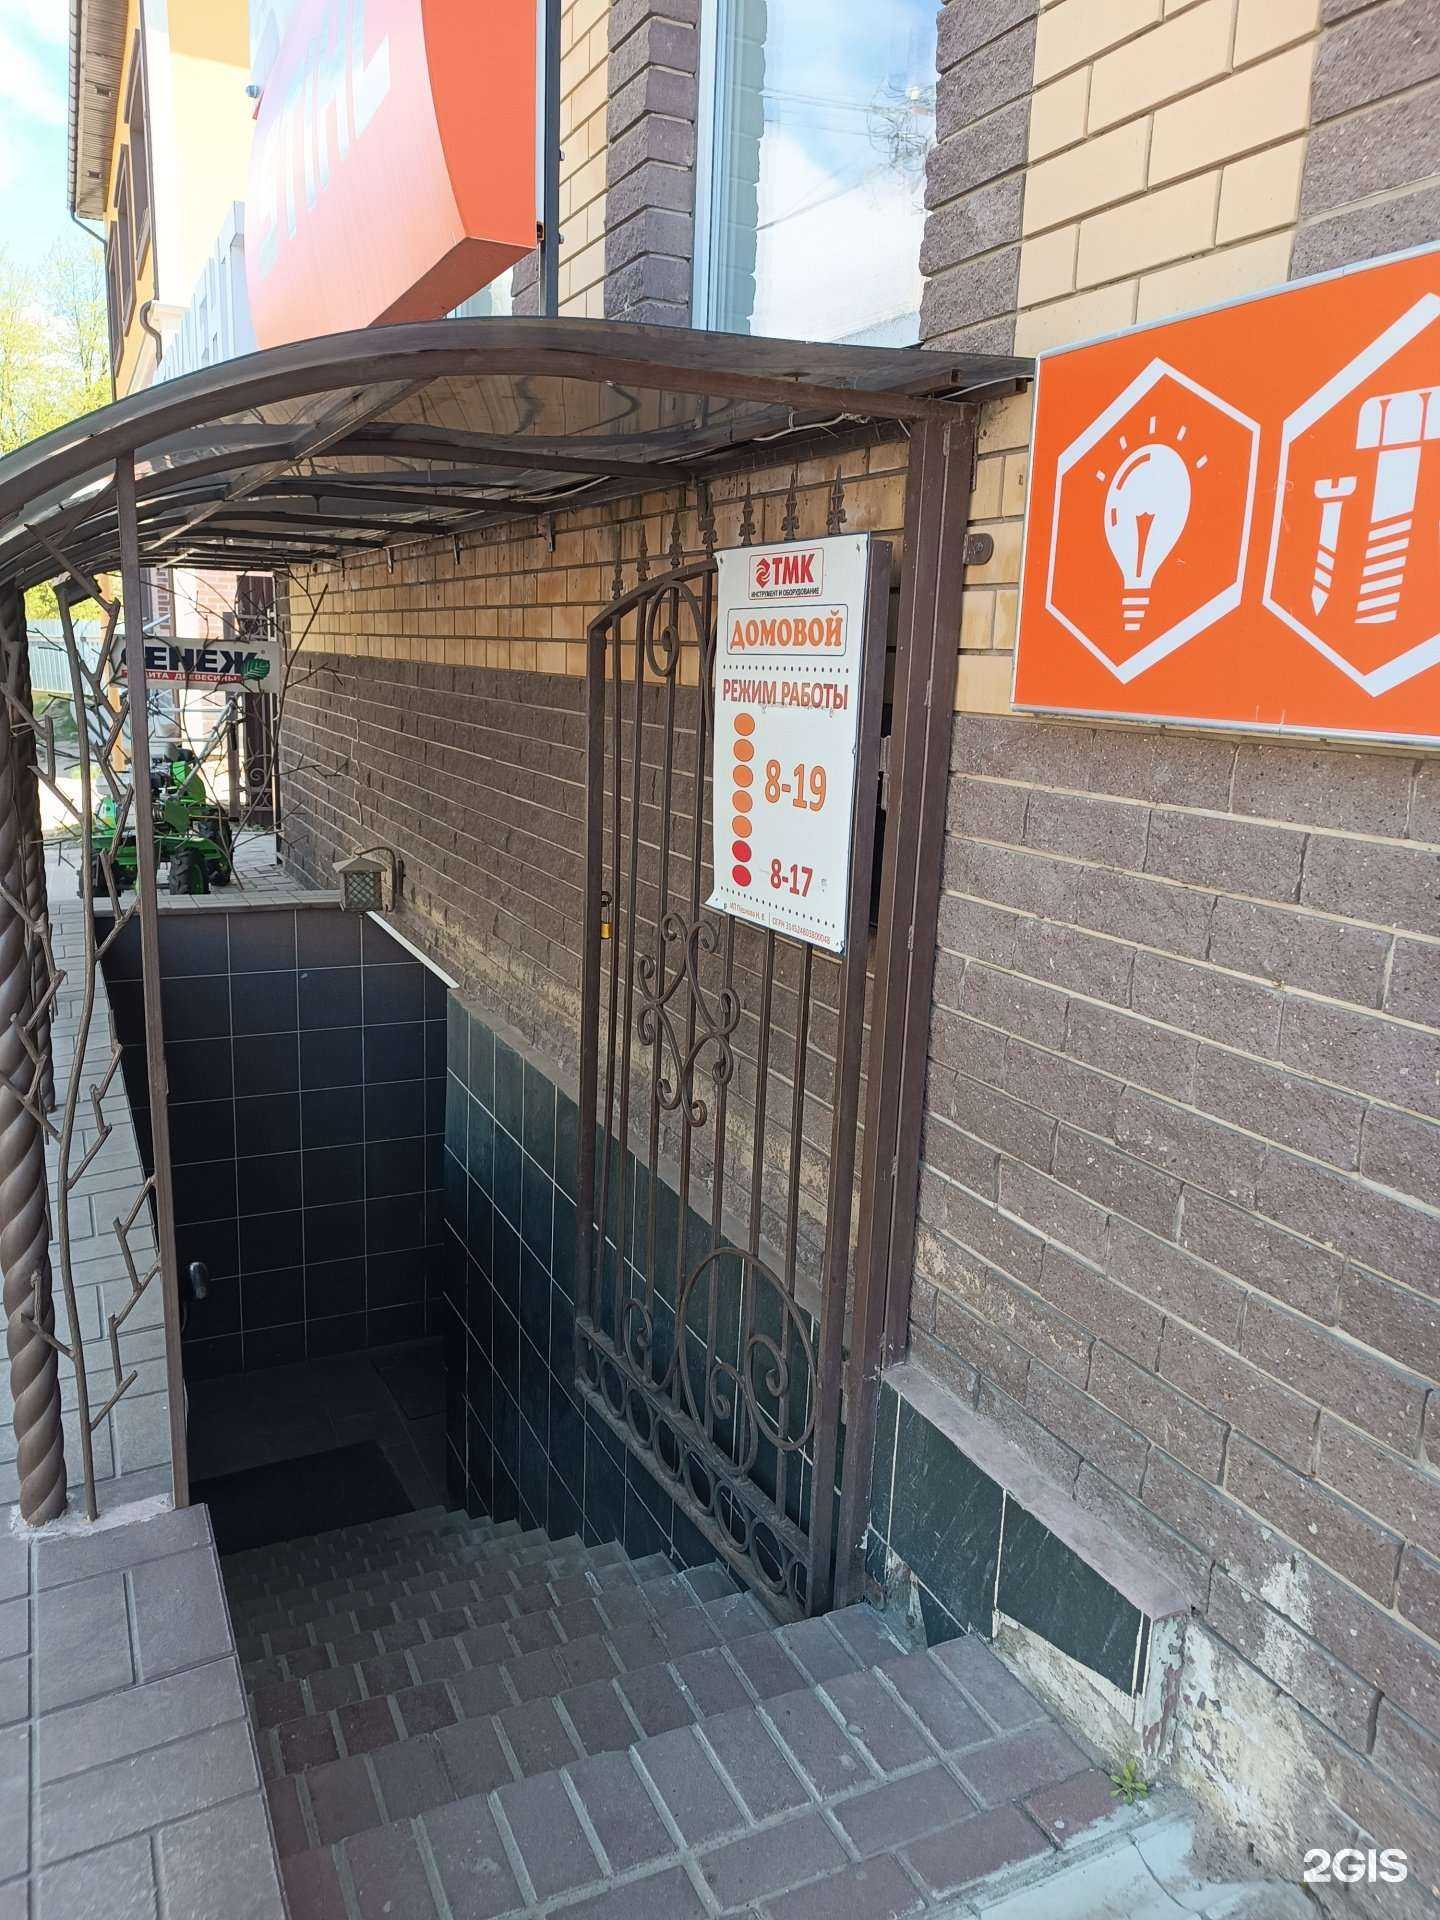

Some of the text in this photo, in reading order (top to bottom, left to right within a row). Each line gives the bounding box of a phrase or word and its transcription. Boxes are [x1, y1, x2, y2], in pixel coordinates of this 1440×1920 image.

[772, 554, 815, 585] ТМК
[730, 609, 843, 650] ДОМОВОЙ
[723, 679, 849, 711] РЕЖИМ РАБОТЫ
[765, 759, 827, 812] 8-19
[770, 858, 813, 897] 8-17
